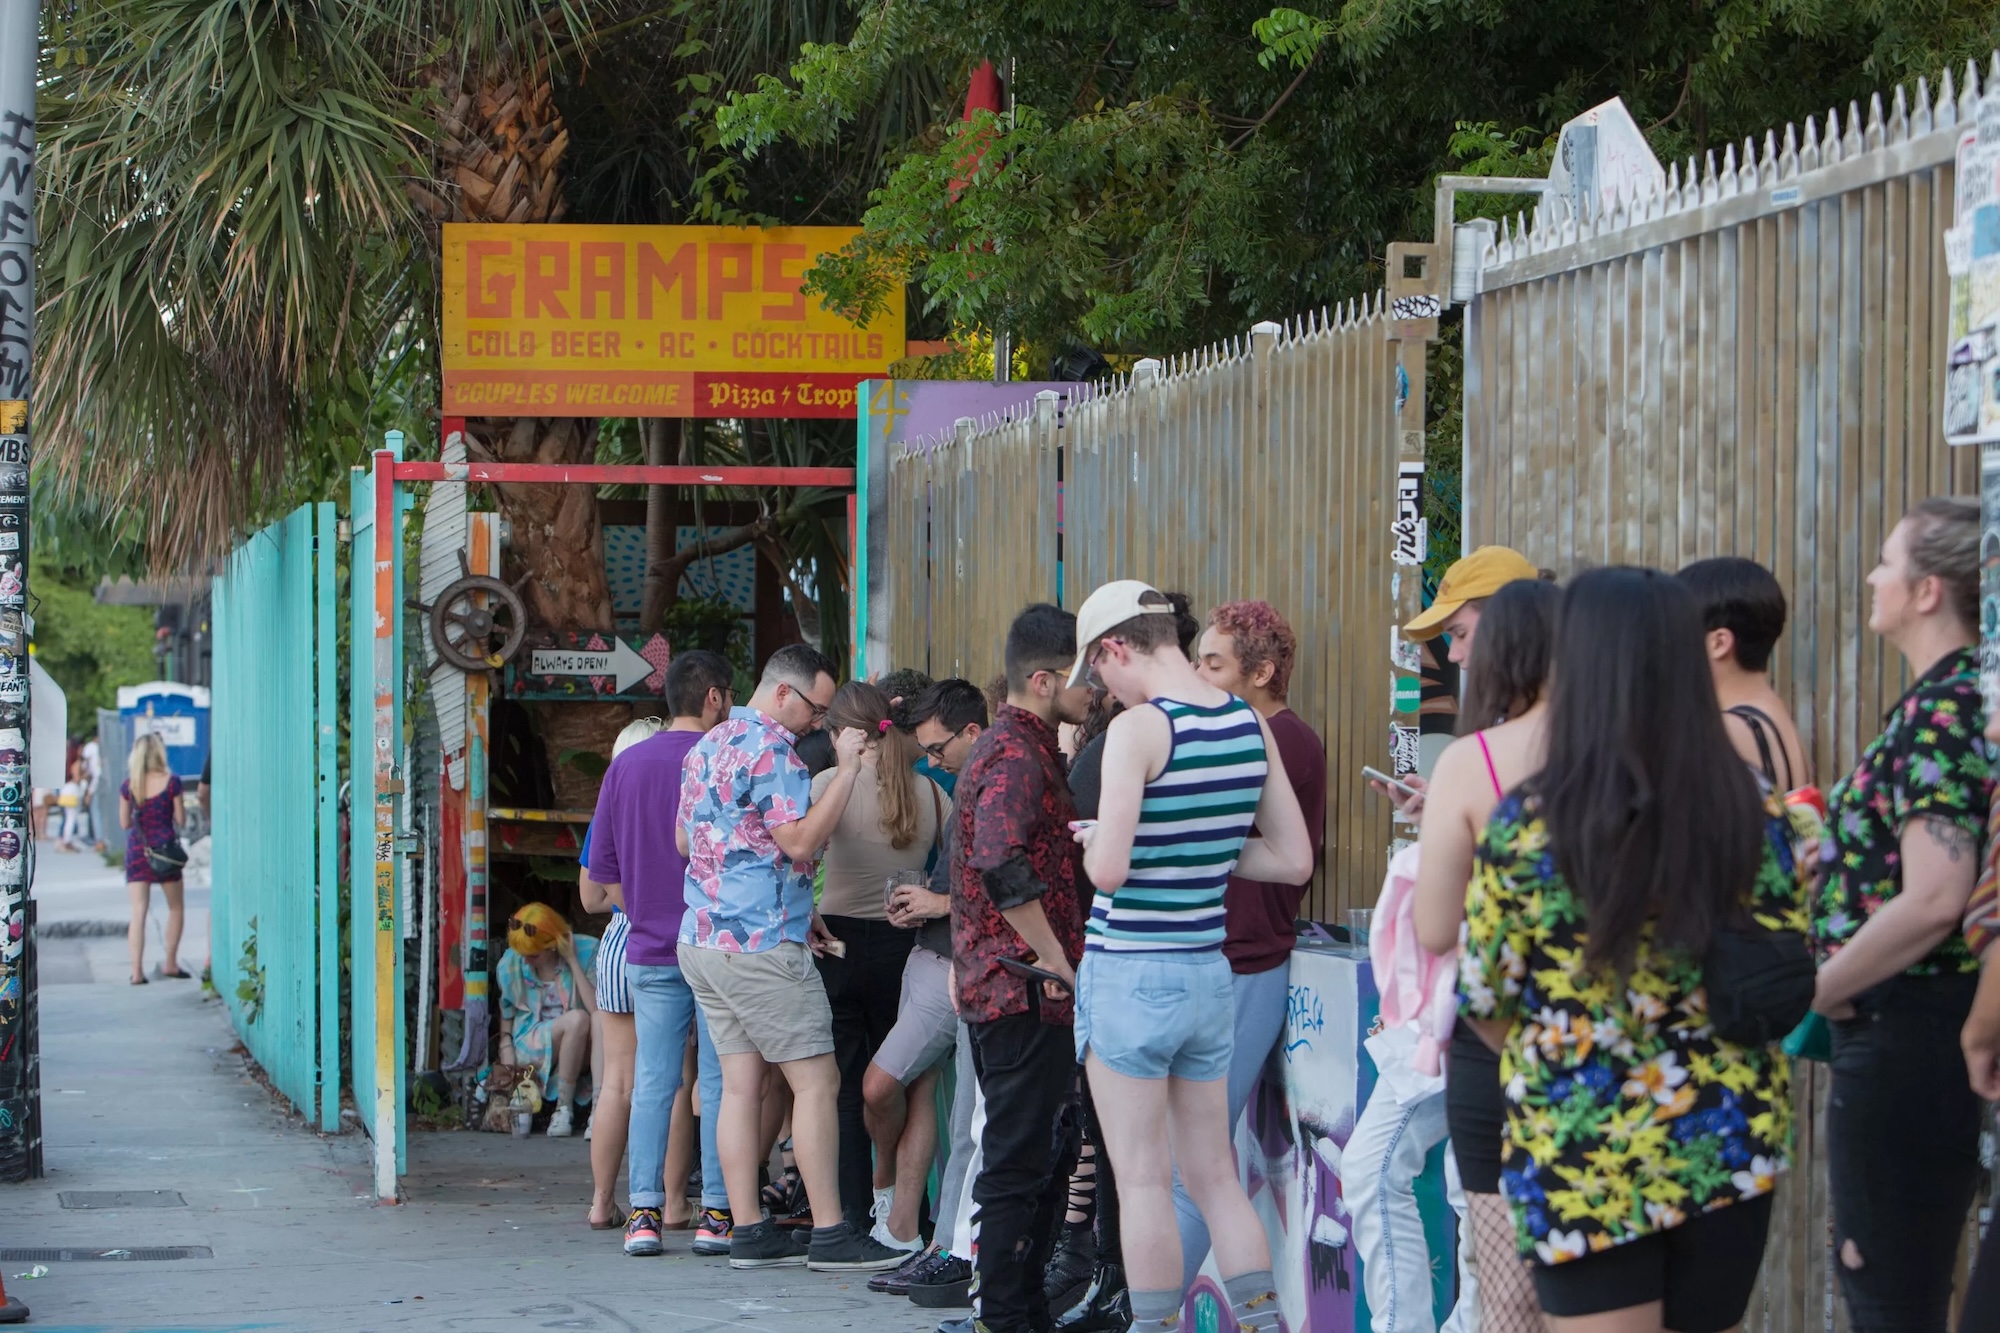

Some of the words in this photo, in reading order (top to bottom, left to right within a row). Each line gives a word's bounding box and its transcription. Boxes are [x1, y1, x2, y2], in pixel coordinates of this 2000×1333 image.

[466, 240, 806, 321] GRAMPS
[467, 330, 536, 358] COLD
[551, 331, 621, 358] BEER
[659, 332, 695, 359] AC
[732, 333, 883, 360] COCKTAILS
[455, 382, 557, 405] COUPLES
[566, 383, 679, 406] WELCOME
[707, 382, 775, 409] Pizza
[534, 656, 573, 671] ALWAYS
[577, 657, 608, 671] OPEN!
